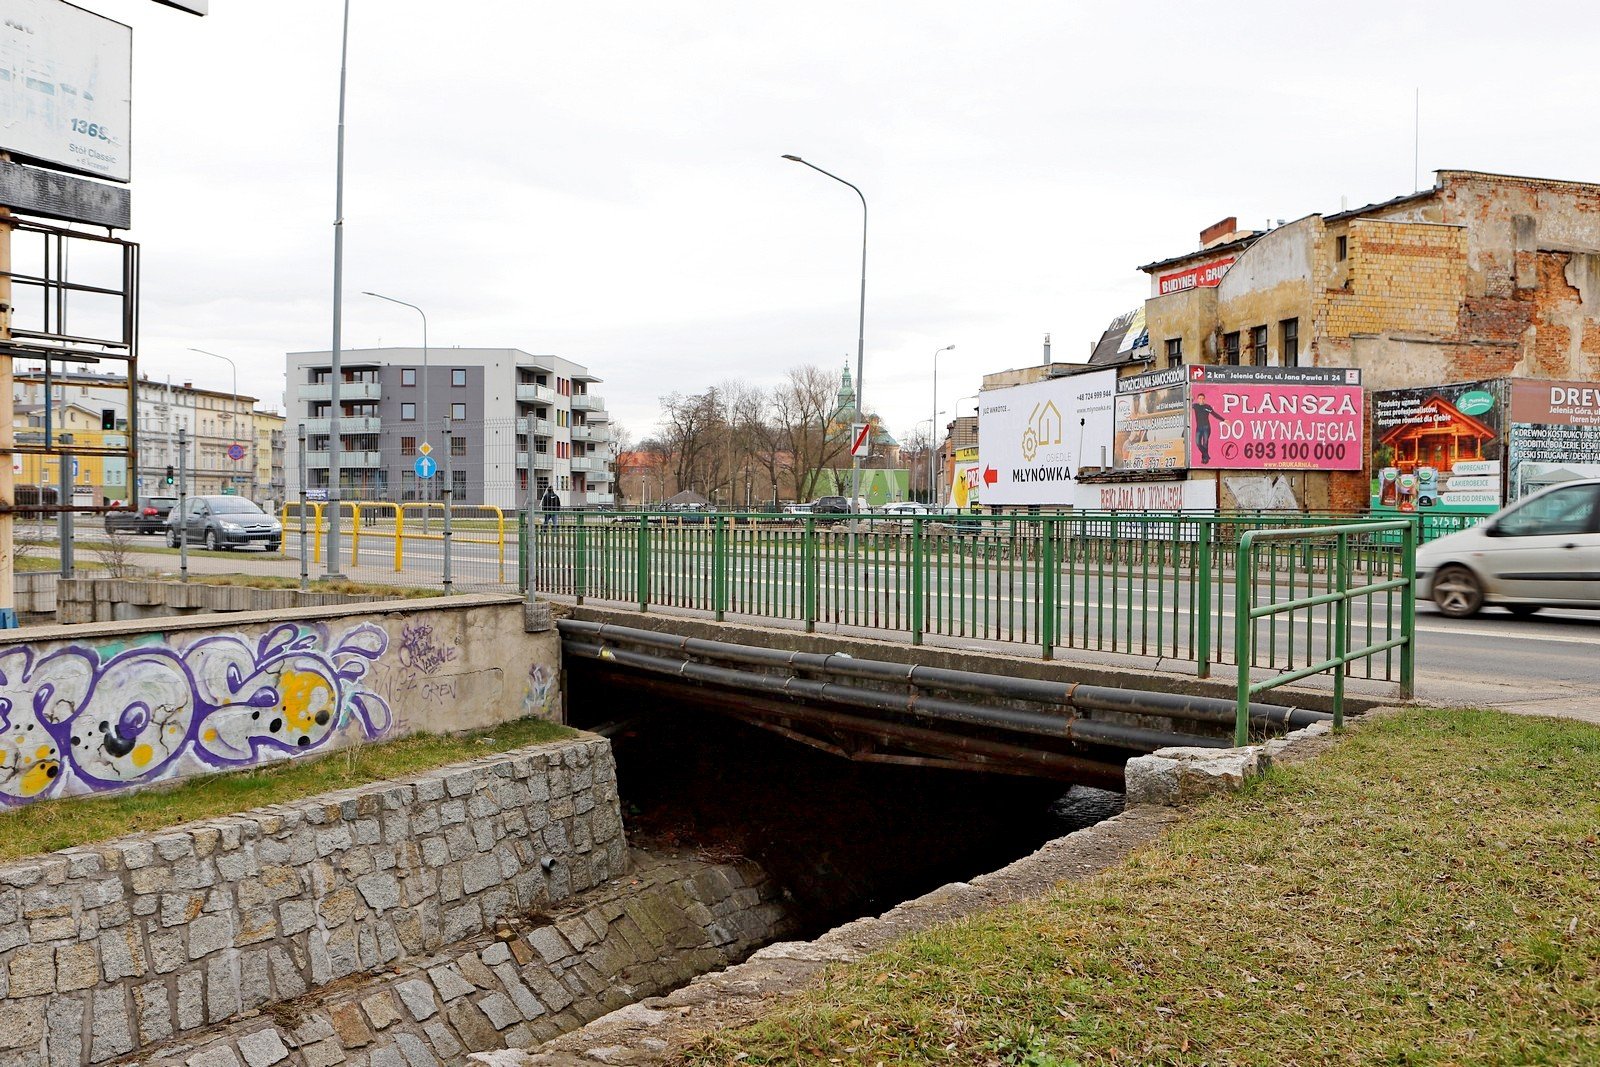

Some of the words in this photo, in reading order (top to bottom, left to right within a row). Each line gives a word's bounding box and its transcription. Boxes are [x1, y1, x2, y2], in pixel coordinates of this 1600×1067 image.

[1162, 273, 1197, 293] BUDYNEK
[1151, 367, 1185, 387] SAMOCHODÓW
[1207, 371, 1212, 379] 2
[1213, 371, 1226, 379] km
[1255, 372, 1274, 380] Góra,
[1222, 392, 1357, 415] PLANSZA
[1378, 400, 1401, 408] Produkty
[1378, 409, 1392, 418] przez
[1549, 405, 1573, 414] Jelenia
[1574, 406, 1593, 415] Góra,
[1424, 415, 1432, 423] dla
[1433, 413, 1452, 422] Ciebie
[1219, 420, 1244, 440] DO
[1250, 419, 1357, 446] WYNAJĘCIA
[1519, 428, 1547, 438] DREWNO
[1243, 442, 1276, 459] 693
[1281, 442, 1309, 460] 100
[1313, 442, 1346, 460] 000
[1519, 450, 1536, 459] DESKI
[1537, 451, 1569, 460] STRUGANE
[1573, 452, 1590, 460] DESKI
[1046, 452, 1071, 462] OSIEDLE
[1012, 465, 1071, 483] MŁYNÓWKA
[1451, 479, 1489, 487] LAKIEROBEJCE
[1101, 487, 1134, 511] REKLAMA
[1138, 487, 1145, 511] DO
